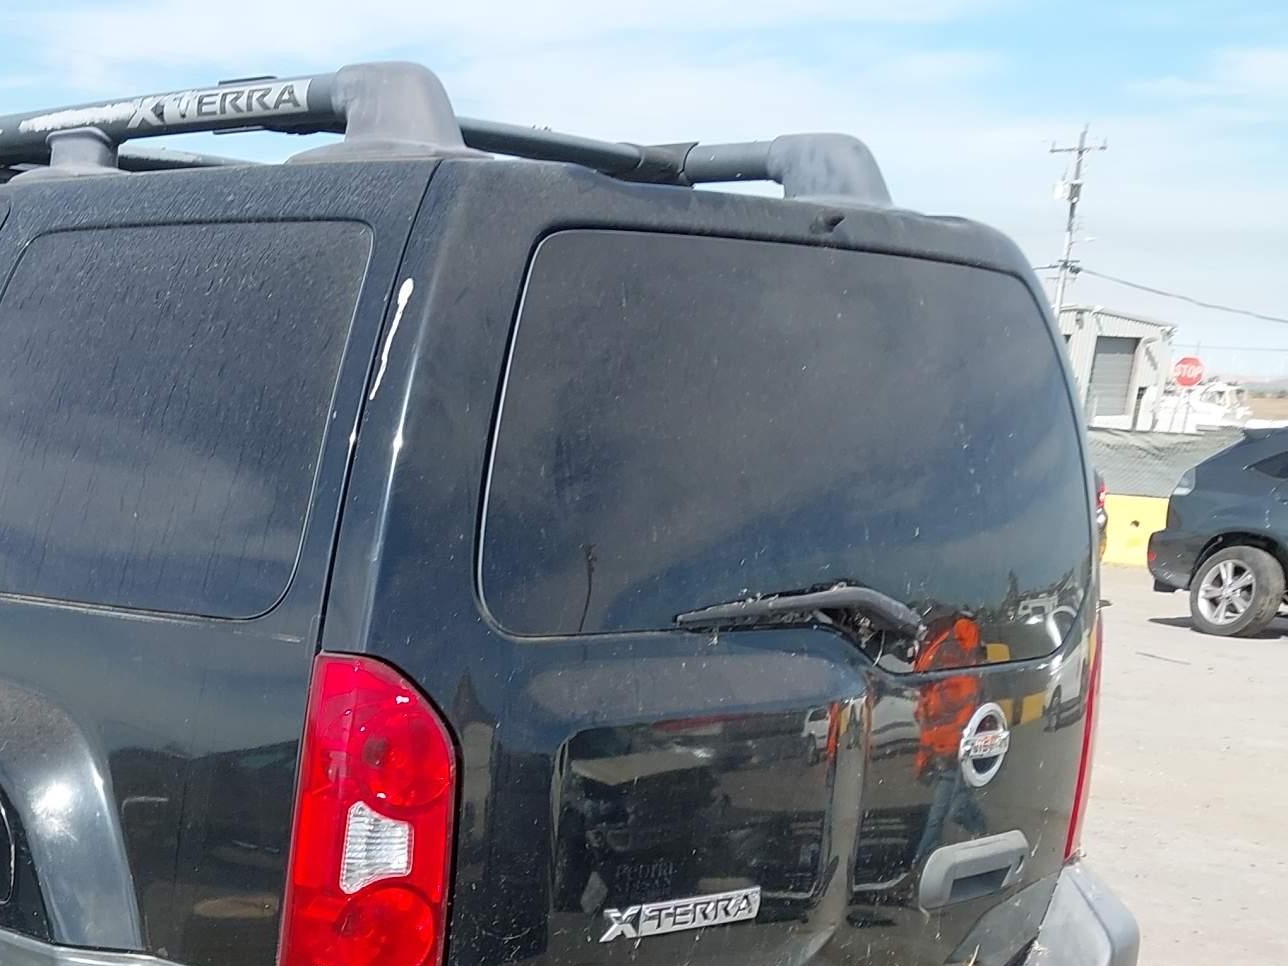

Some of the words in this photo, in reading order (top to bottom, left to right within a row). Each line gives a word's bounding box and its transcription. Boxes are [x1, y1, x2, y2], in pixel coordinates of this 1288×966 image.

[126, 83, 302, 129] XTERRA
[1174, 363, 1202, 378] STOP
[599, 892, 755, 942] XTERRA
